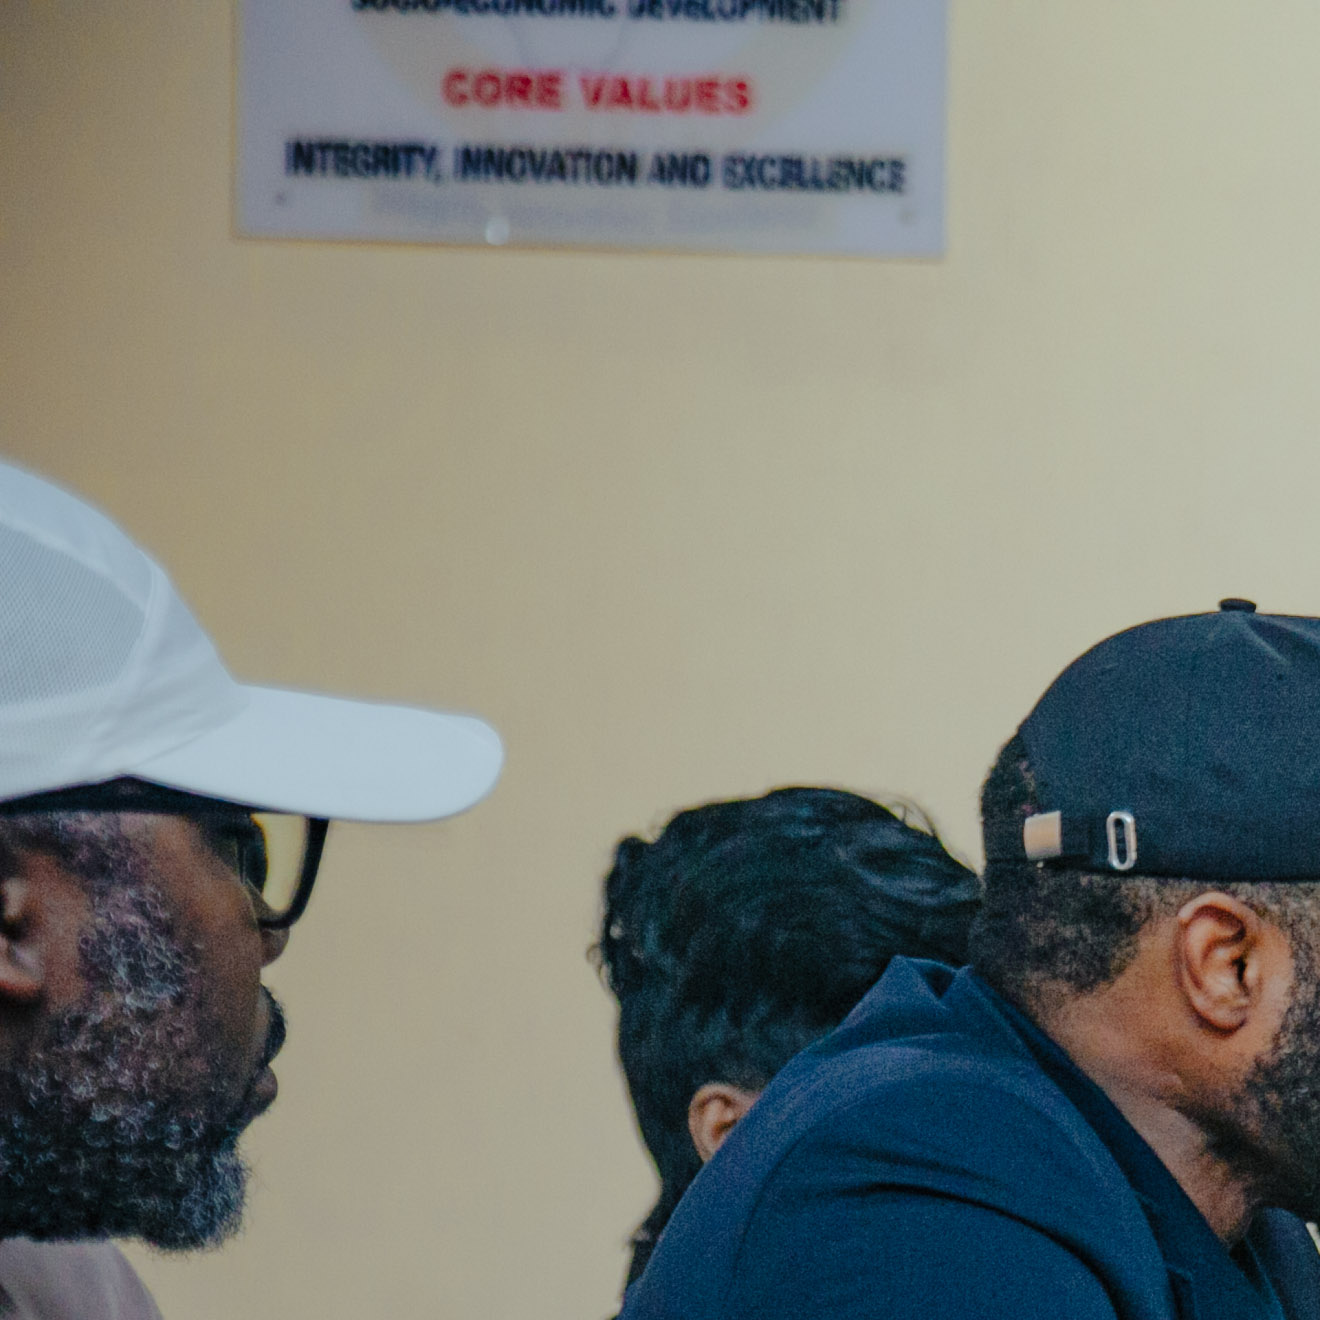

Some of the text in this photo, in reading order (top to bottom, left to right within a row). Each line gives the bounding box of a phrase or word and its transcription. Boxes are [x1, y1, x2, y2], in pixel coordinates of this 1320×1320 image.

[443, 70, 753, 114] CORE VALUES
[286, 140, 906, 195] INTEGRITY, INNOVATION AND EXCELLENCE
